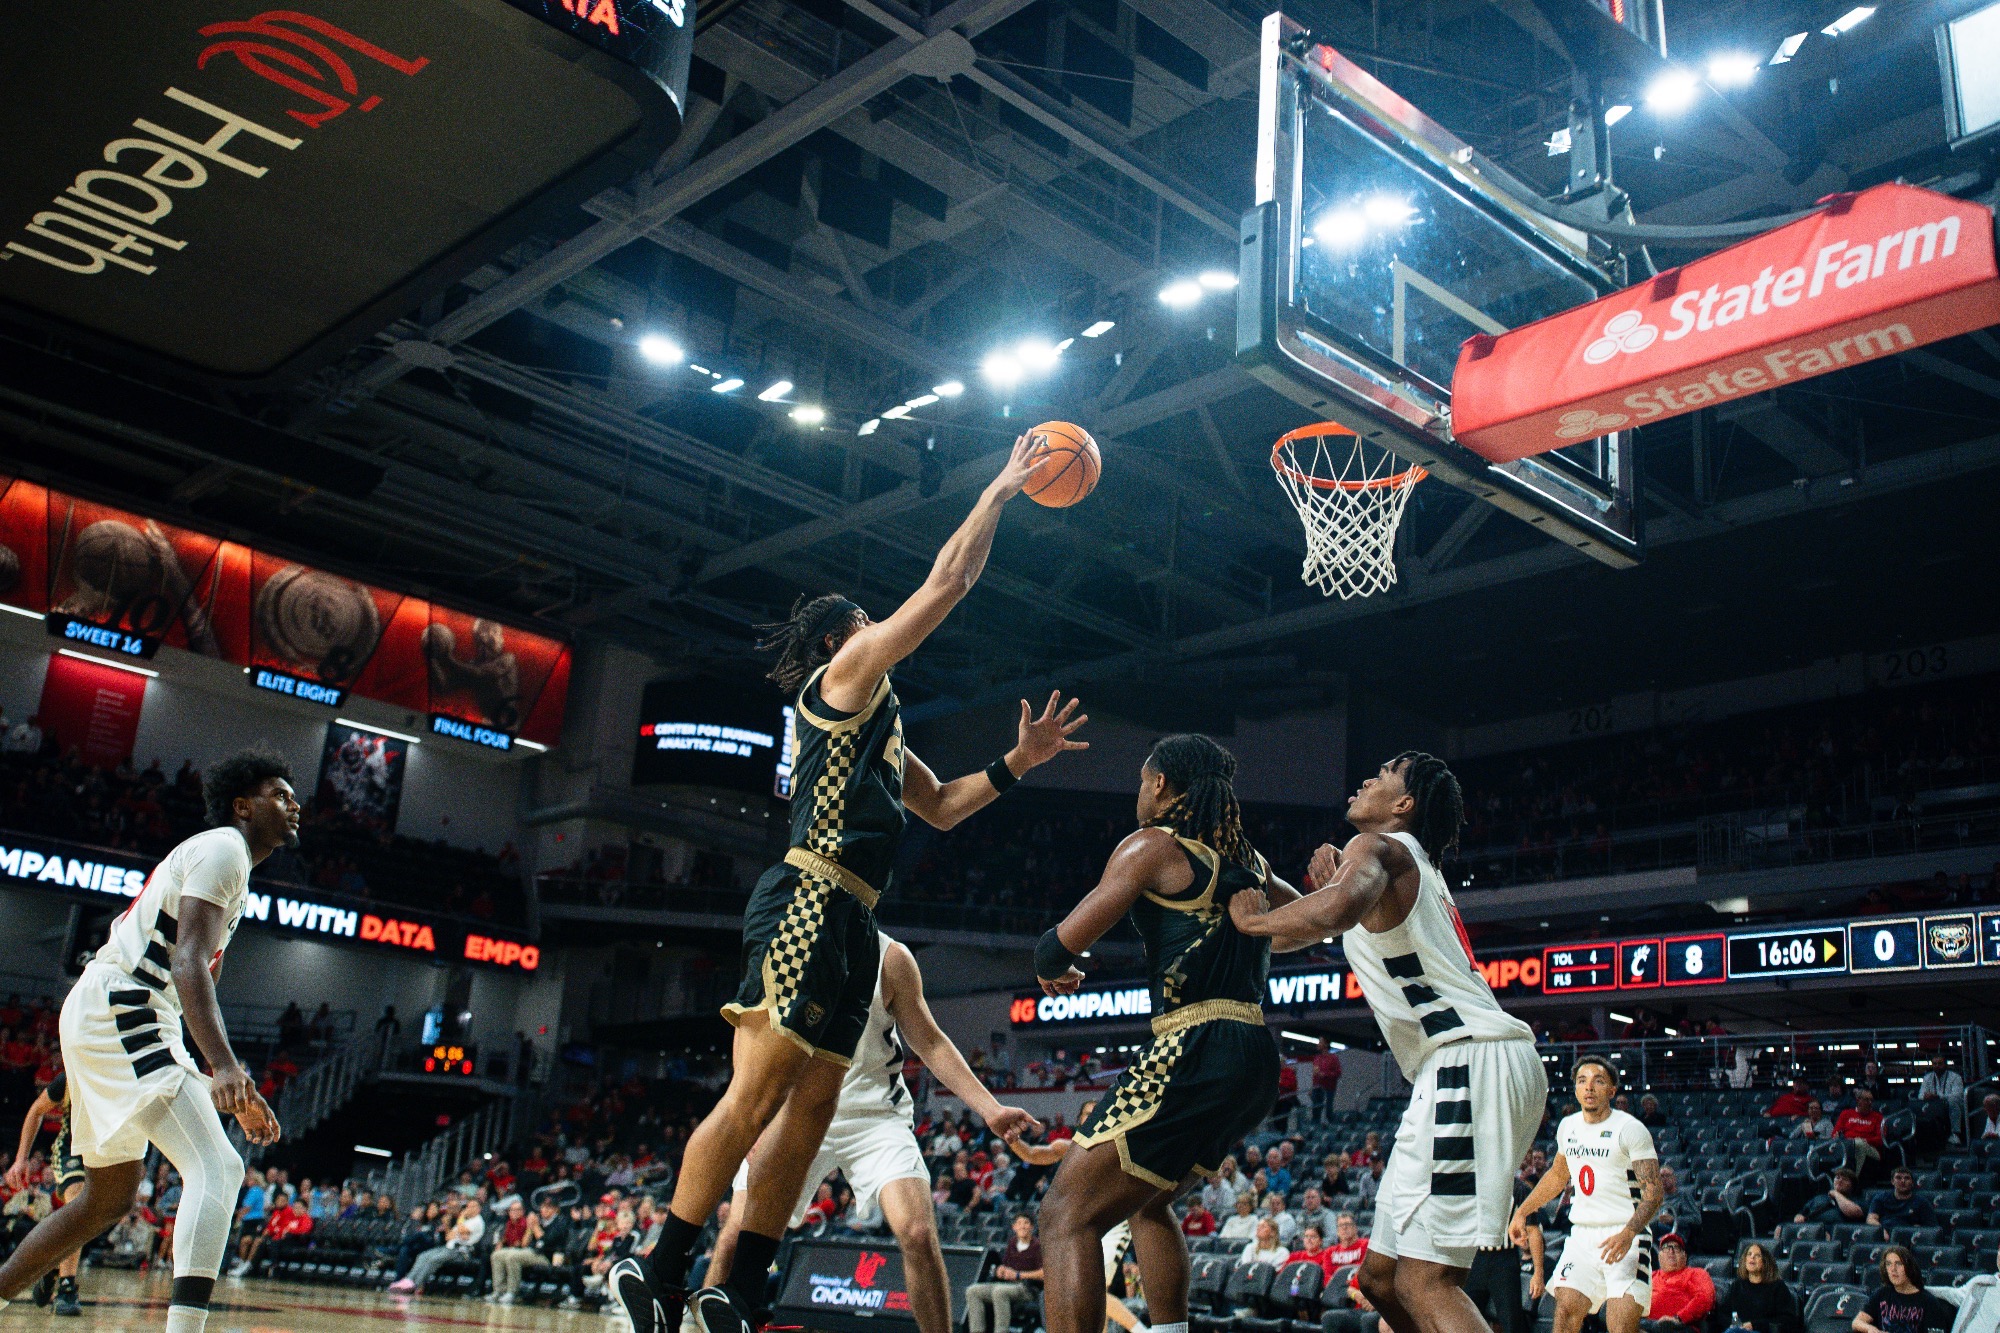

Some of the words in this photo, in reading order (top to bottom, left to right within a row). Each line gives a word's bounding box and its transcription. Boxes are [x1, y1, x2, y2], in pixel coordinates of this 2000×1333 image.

[6, 86, 303, 275] Health
[65, 621, 121, 648] SWEET
[122, 636, 142, 654] 16
[1885, 646, 1948, 680] 203
[257, 671, 295, 694] ELITE
[697, 723, 721, 738] FOR
[277, 898, 357, 937] WITH
[359, 913, 435, 952] DATA
[464, 934, 540, 971] EMPO
[1874, 930, 1895, 961] 0
[1553, 952, 1573, 966] TOL
[1589, 950, 1597, 964] 4
[1685, 944, 1703, 975] 8
[1758, 938, 1816, 967] 16:06
[1268, 973, 1340, 1004] WITH
[1553, 973, 1572, 986] FLS
[1591, 970, 1597, 984] 1
[1566, 1146, 1609, 1158] CINCINNATI
[1579, 1165, 1595, 1196] 0
